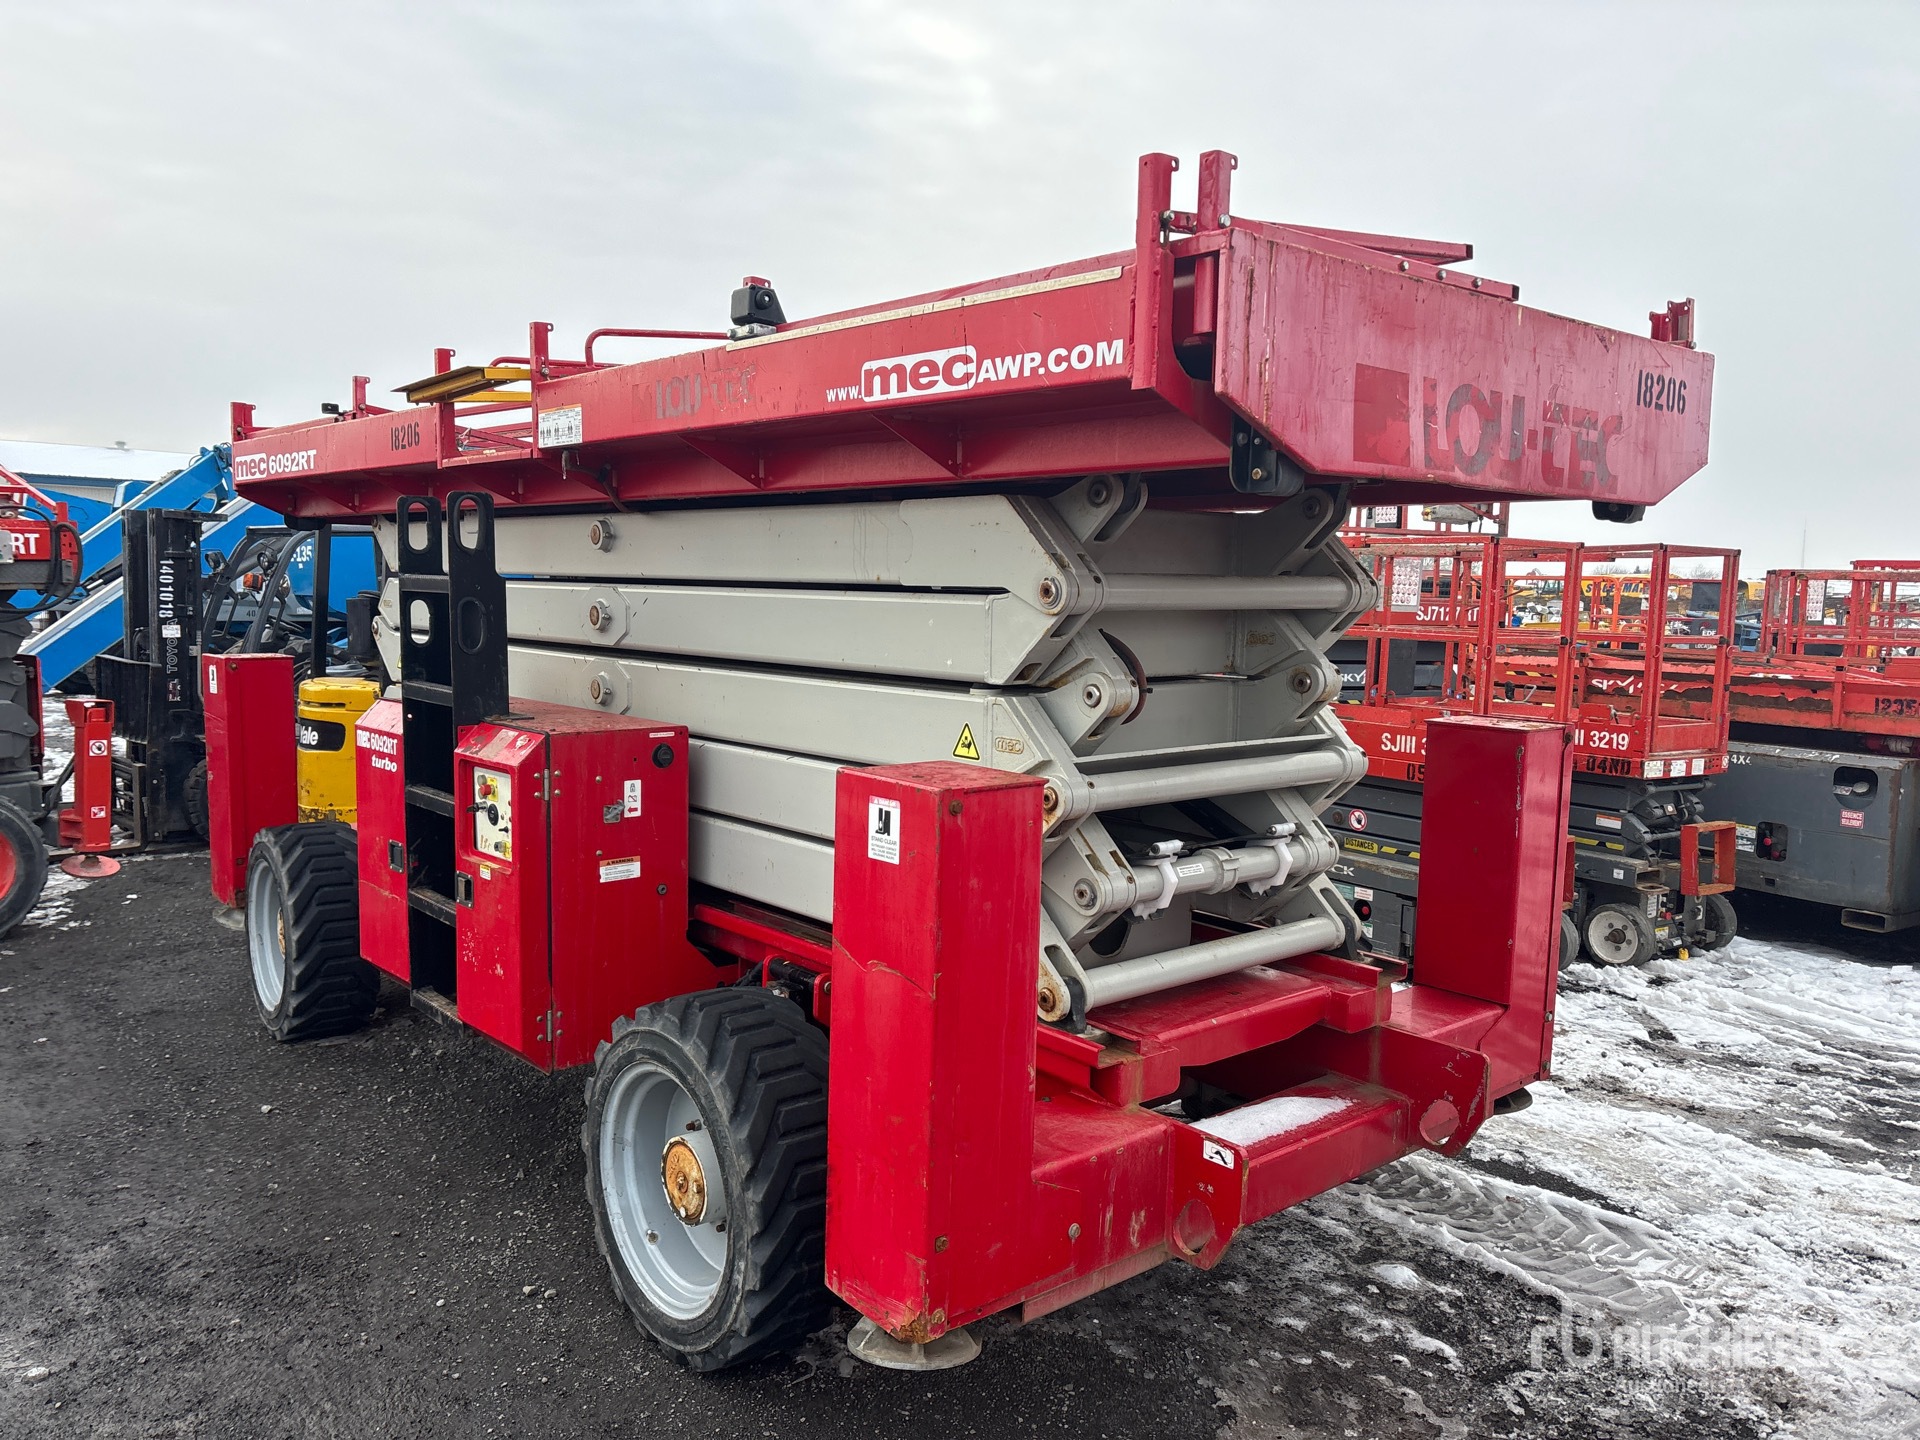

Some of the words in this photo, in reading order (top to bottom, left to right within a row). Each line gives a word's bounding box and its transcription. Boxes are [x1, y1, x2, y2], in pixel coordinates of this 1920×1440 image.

[1637, 368, 1688, 415] 18206
[390, 424, 420, 451] 18206
[268, 450, 317, 474] 6092RT
[158, 559, 175, 618] 1401018
[166, 618, 178, 674] TOYOA
[1589, 730, 1629, 750] 3219
[371, 754, 398, 773] turbo
[1345, 838, 1375, 851] DISTANCES
[611, 857, 634, 865] WARNING
